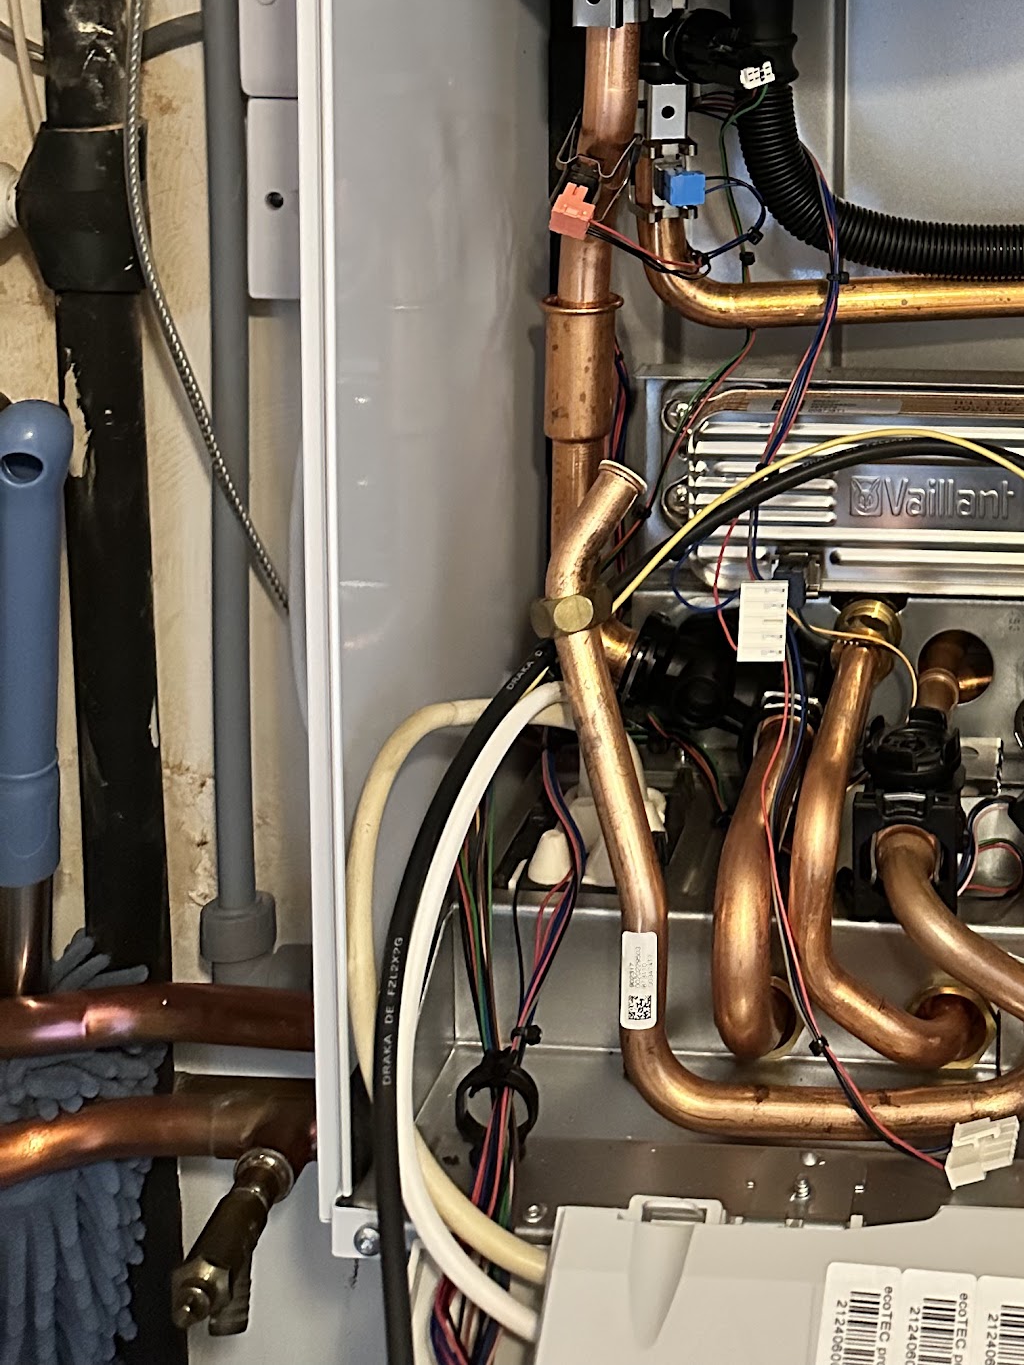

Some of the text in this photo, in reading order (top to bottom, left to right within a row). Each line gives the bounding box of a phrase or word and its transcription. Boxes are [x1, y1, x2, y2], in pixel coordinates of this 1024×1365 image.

[883, 477, 1015, 520] Vaillant
[506, 661, 535, 690] DRAKA
[384, 1005, 395, 1024] DE
[382, 1034, 393, 1086] DRAKA
[830, 1300, 848, 1365] 2124060
[879, 1286, 893, 1342] ecoTEC
[955, 1293, 968, 1349] ecoTEC
